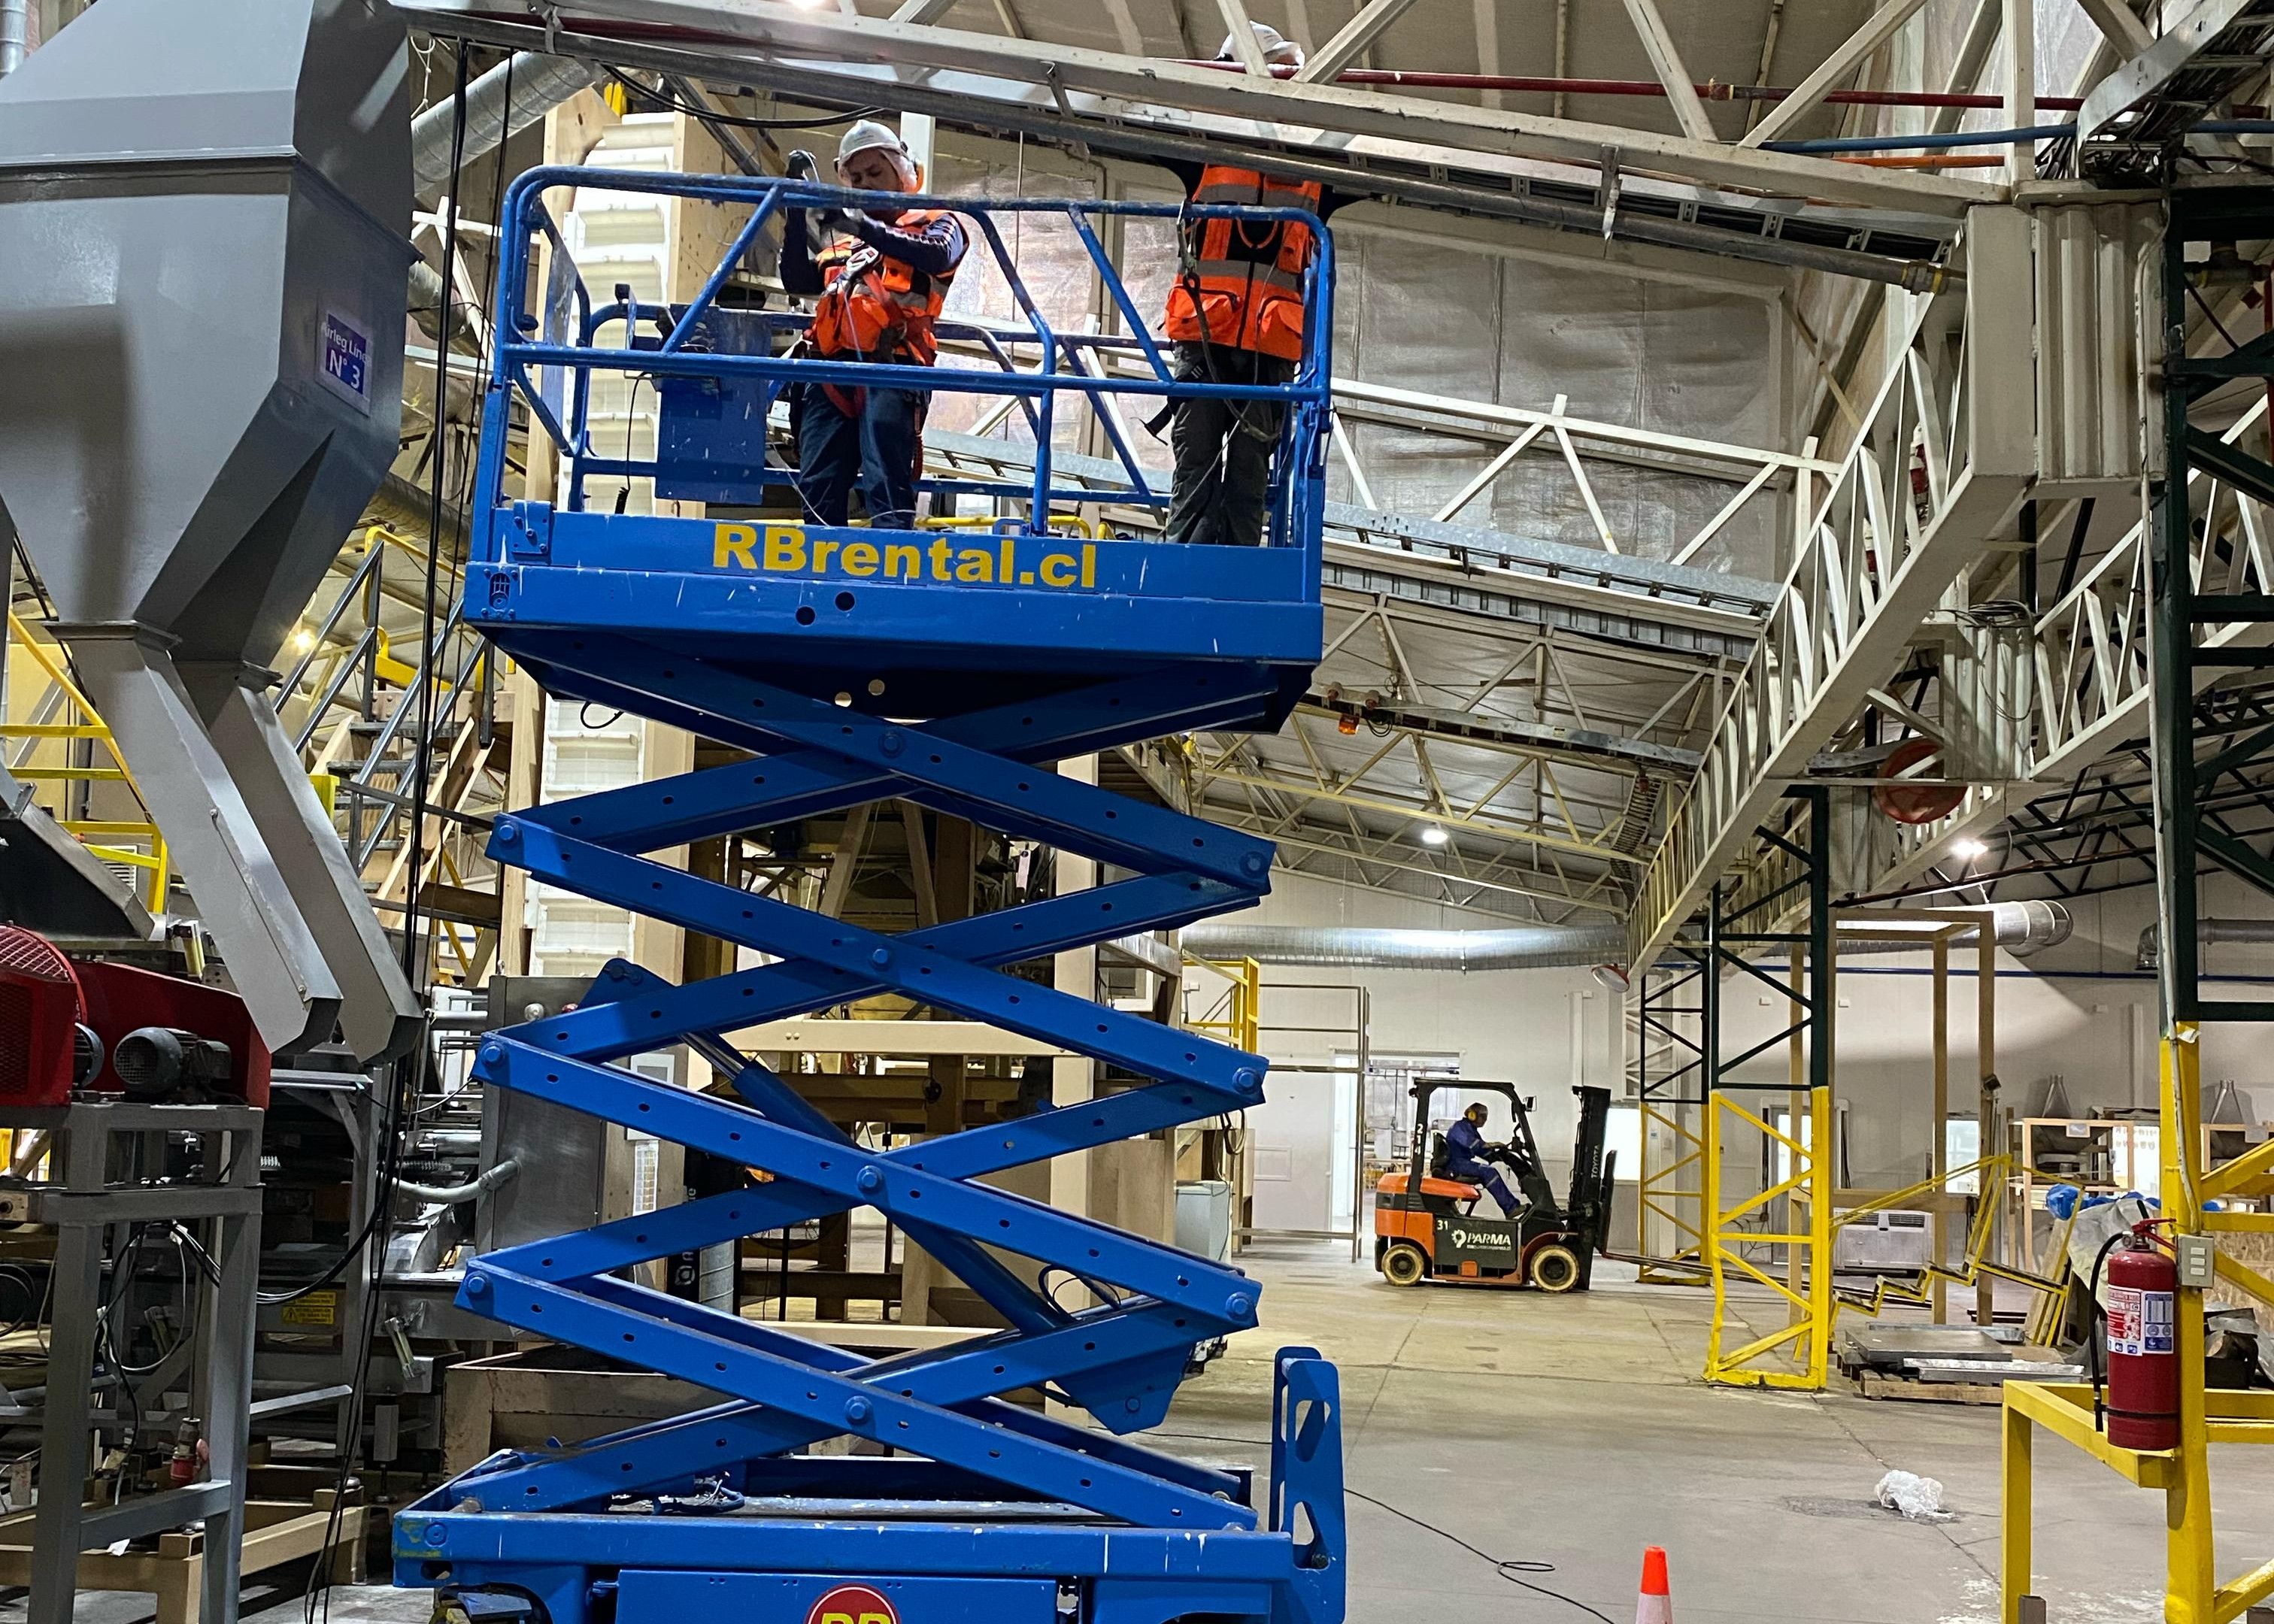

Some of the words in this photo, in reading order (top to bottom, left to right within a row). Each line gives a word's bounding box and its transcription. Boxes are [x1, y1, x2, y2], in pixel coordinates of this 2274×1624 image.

[350, 365, 360, 389] 3
[712, 523, 1097, 588] RBrental.cl
[1414, 1123, 1424, 1155] 214
[1590, 1144, 1599, 1178] TOYOTA
[1437, 1220, 1448, 1230] 31
[1467, 1232, 1511, 1245] PARMA
